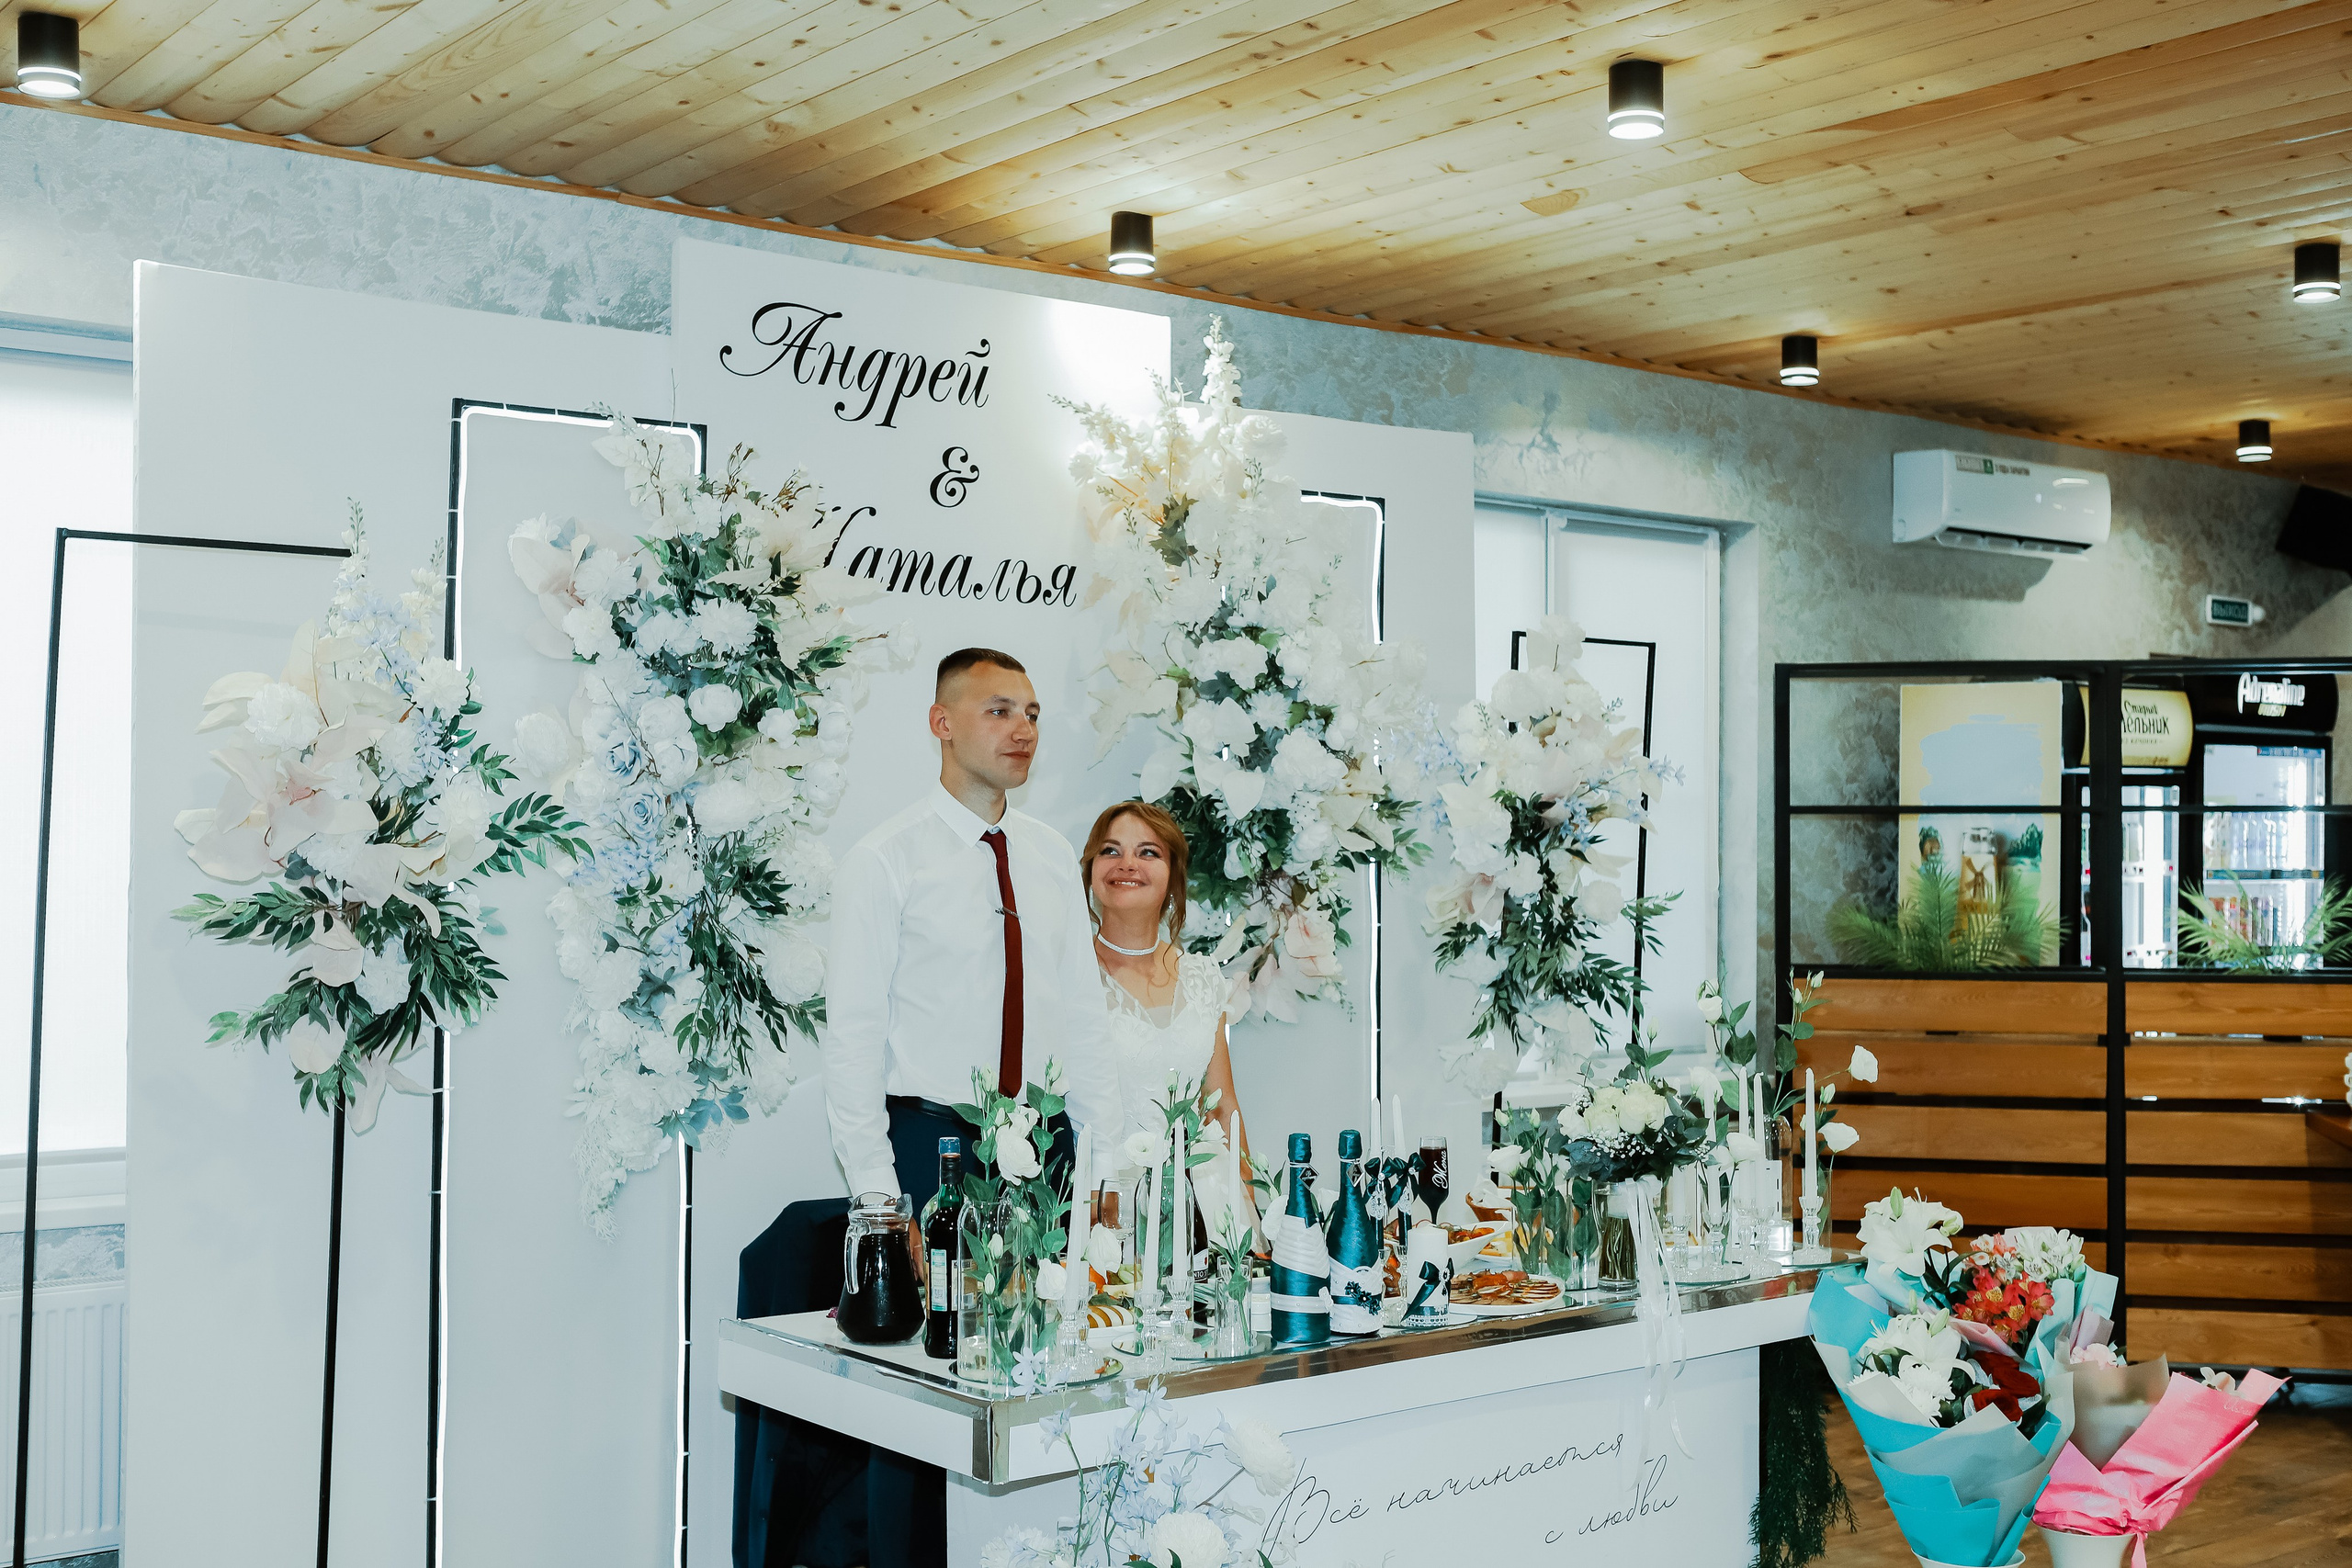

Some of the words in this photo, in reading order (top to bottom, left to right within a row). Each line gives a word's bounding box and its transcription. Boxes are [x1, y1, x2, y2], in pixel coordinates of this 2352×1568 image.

[719, 301, 990, 429] Андрей
[929, 446, 979, 508] &
[1261, 1457, 1370, 1562] Всё
[1387, 1433, 1623, 1513] начинается
[1544, 1530, 1564, 1543] с
[1578, 1454, 1679, 1535] любви
